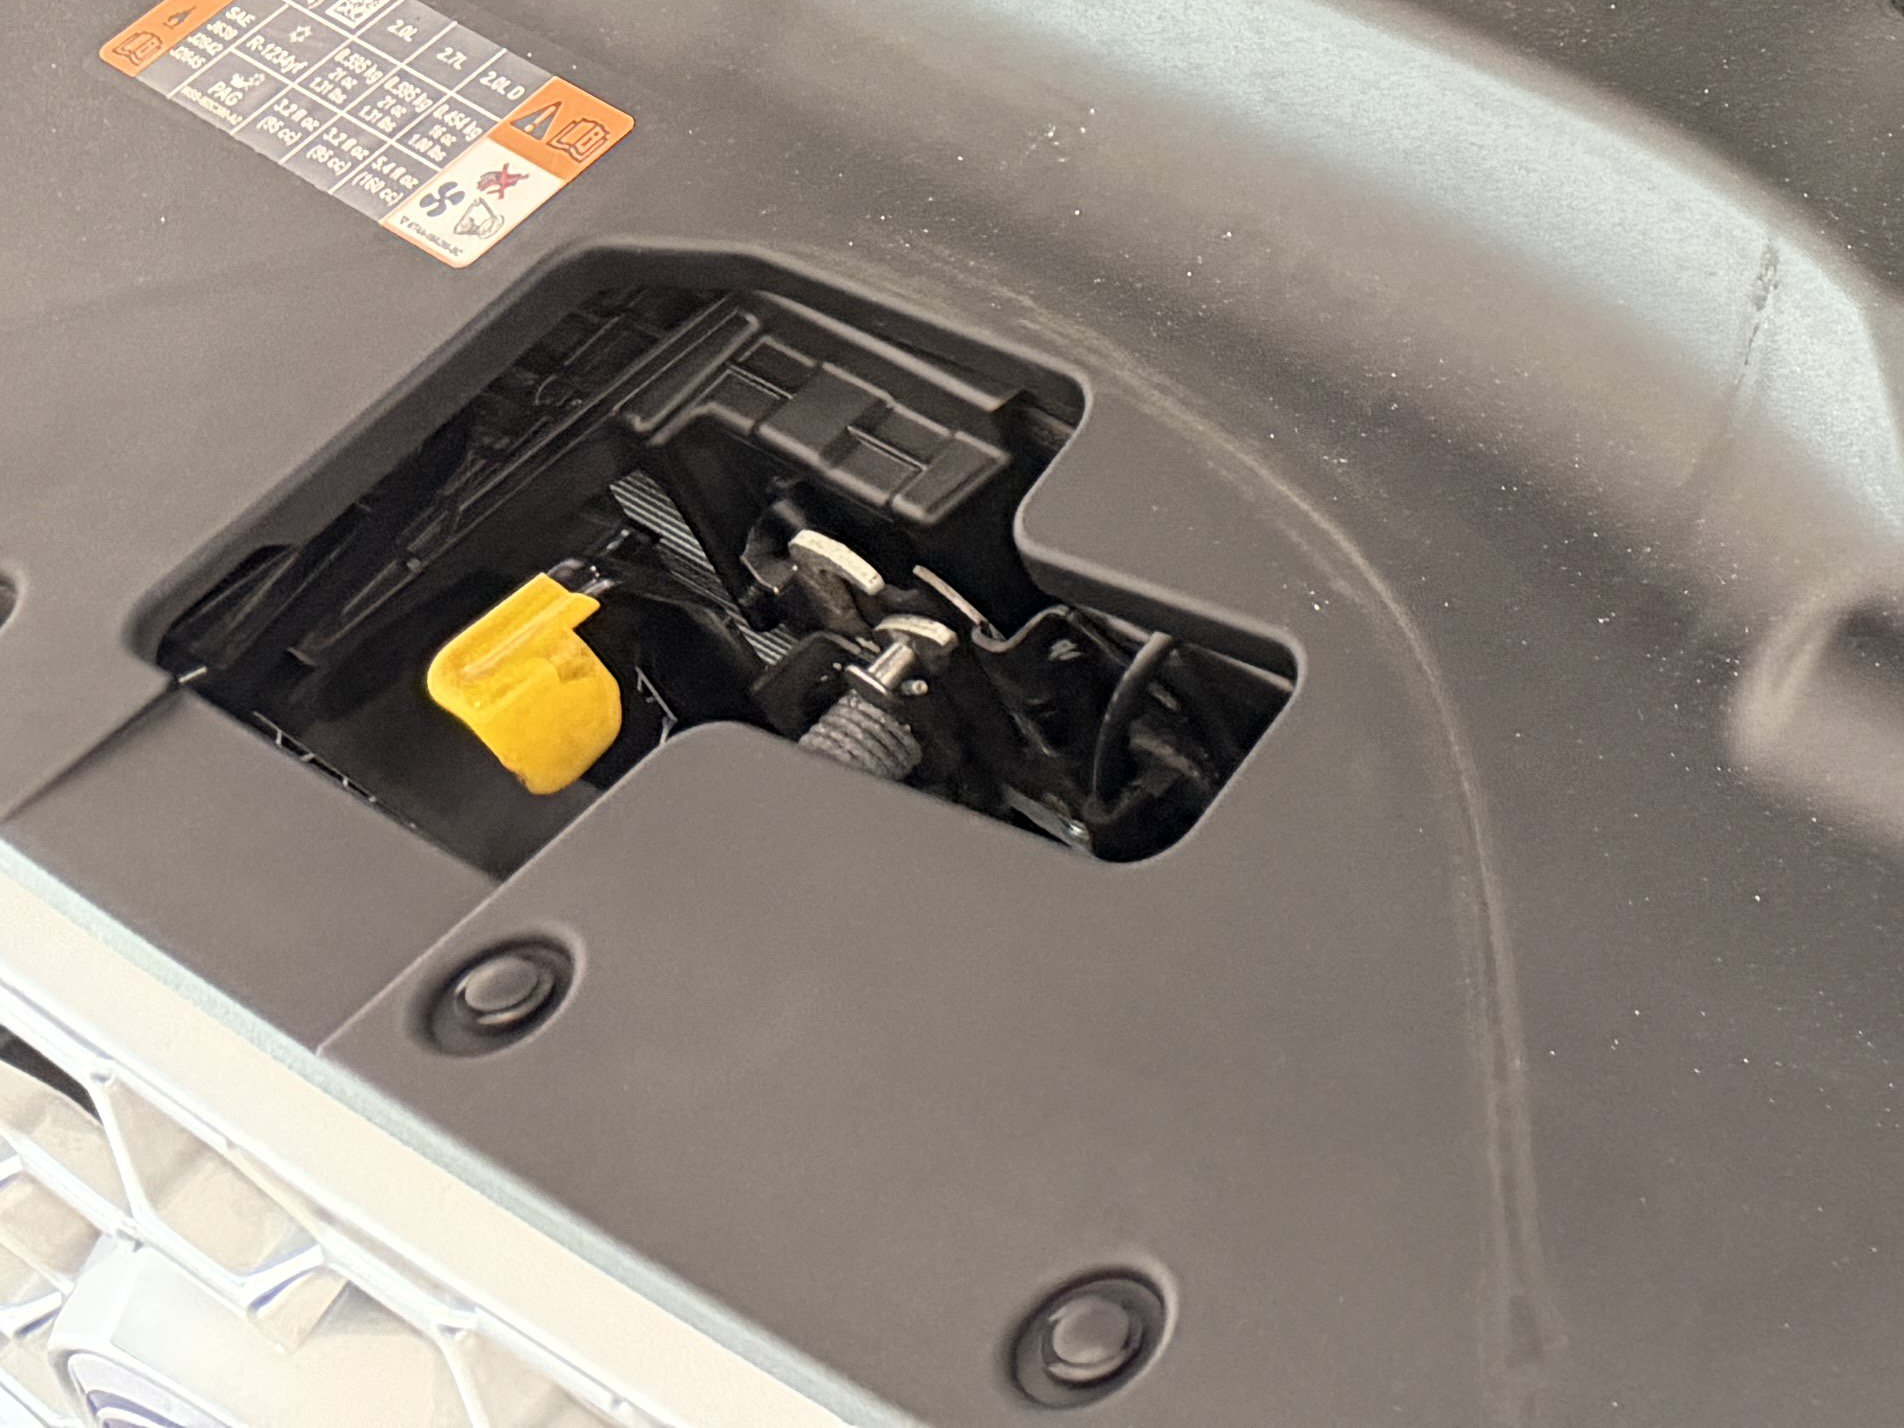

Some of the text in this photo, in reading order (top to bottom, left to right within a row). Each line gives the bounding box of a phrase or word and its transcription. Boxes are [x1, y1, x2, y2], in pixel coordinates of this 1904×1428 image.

[226, 6, 256, 27] SAE
[387, 19, 418, 42] 2.0L
[246, 35, 308, 74] R-1234yf
[436, 47, 468, 70] 2.7L
[207, 81, 243, 106] PAG
[479, 71, 525, 100] 2.0L D
[273, 98, 298, 117] 3.2
[301, 117, 320, 132] oz
[323, 127, 348, 146] 3.2
[350, 145, 370, 160] oz
[371, 156, 396, 174] 5.4
[400, 174, 419, 189] oz
